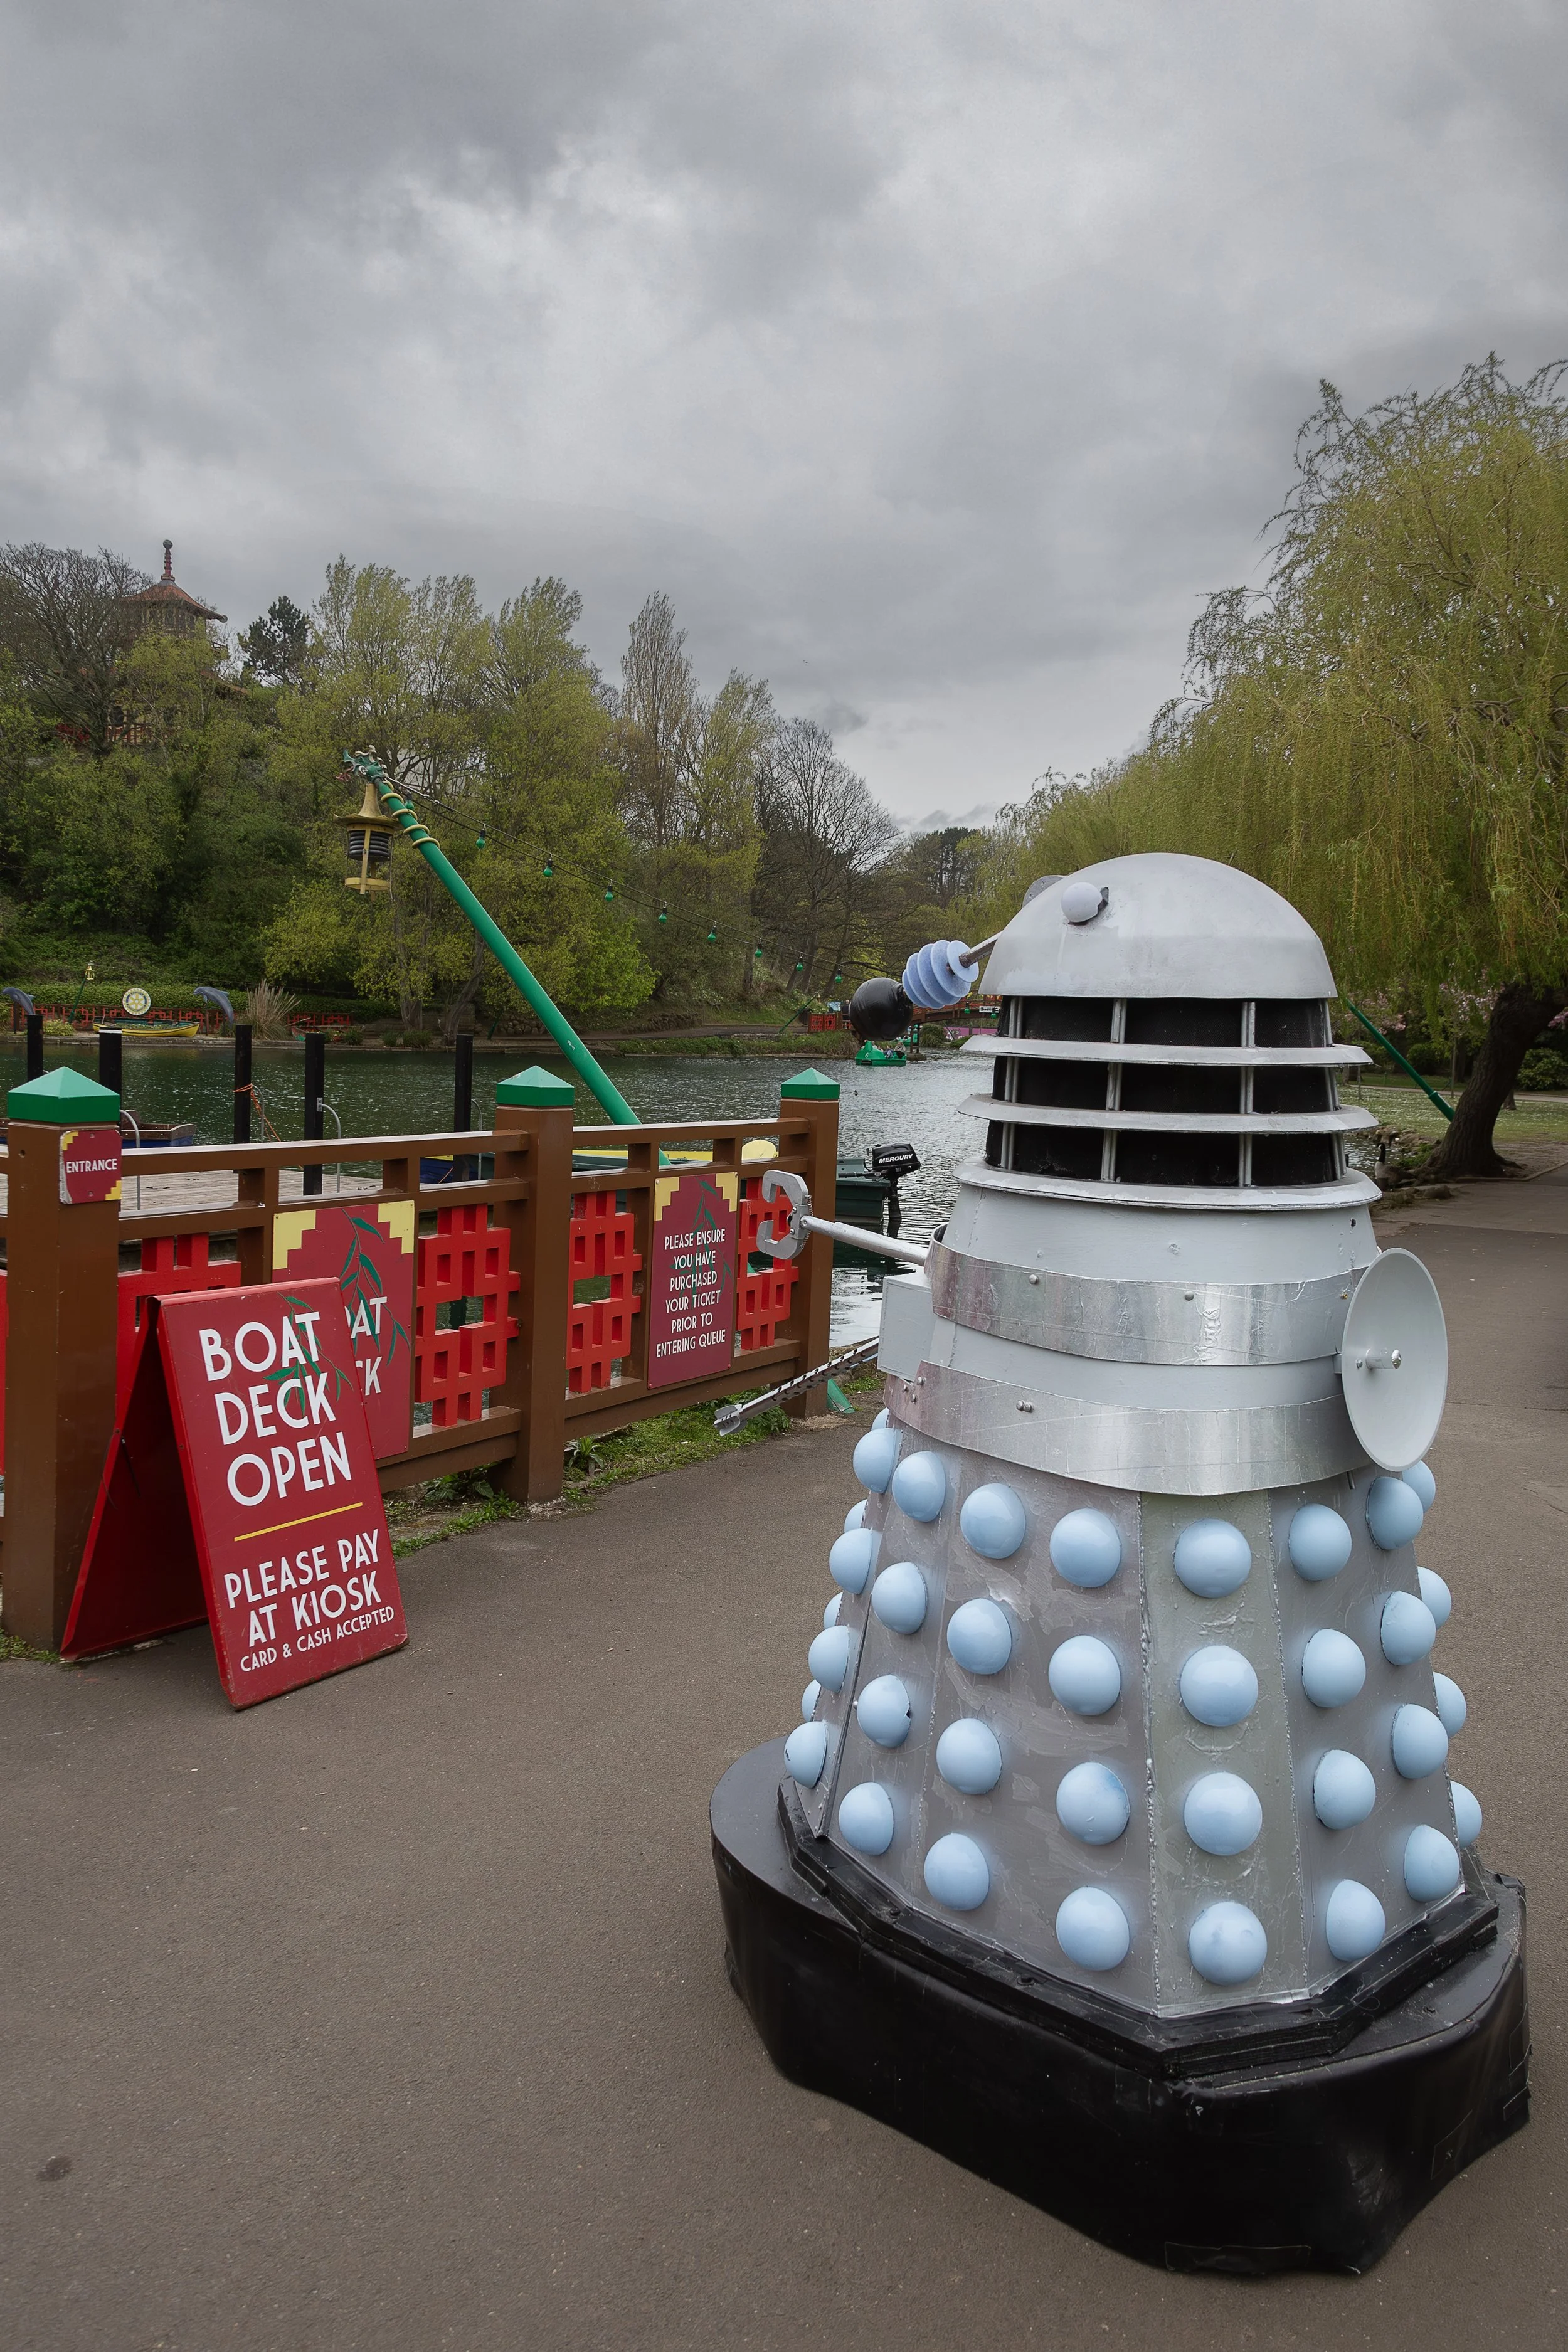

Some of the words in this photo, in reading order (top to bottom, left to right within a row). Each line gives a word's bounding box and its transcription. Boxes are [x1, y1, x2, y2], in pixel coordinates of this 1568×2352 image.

[66, 1158, 118, 1173] ENTRANCE
[878, 1153, 913, 1164] MERCURY
[664, 1232, 694, 1251] PLEASE
[696, 1228, 726, 1246] ENSURE
[674, 1253, 692, 1270] YOU
[695, 1250, 716, 1266] HAVE
[670, 1270, 718, 1292] PURCHASED
[665, 1296, 689, 1313] YOUR
[692, 1290, 721, 1308] TICKET
[344, 1296, 388, 1339] AT
[671, 1315, 697, 1333] PRIOR
[700, 1312, 713, 1327] TO
[199, 1311, 320, 1382] BOAT
[656, 1335, 696, 1358] ENTERING
[699, 1329, 726, 1348] QUEUE
[214, 1372, 337, 1446] DECK
[227, 1431, 352, 1507] OPEN
[224, 1545, 330, 1609] PLEASE
[337, 1528, 379, 1572] PAY
[249, 1602, 278, 1648] AT
[291, 1570, 382, 1631] KIOSK
[240, 1647, 277, 1672] CARD
[282, 1643, 293, 1658] &
[296, 1628, 332, 1652] CASH
[336, 1606, 395, 1640] ACCEPTED
